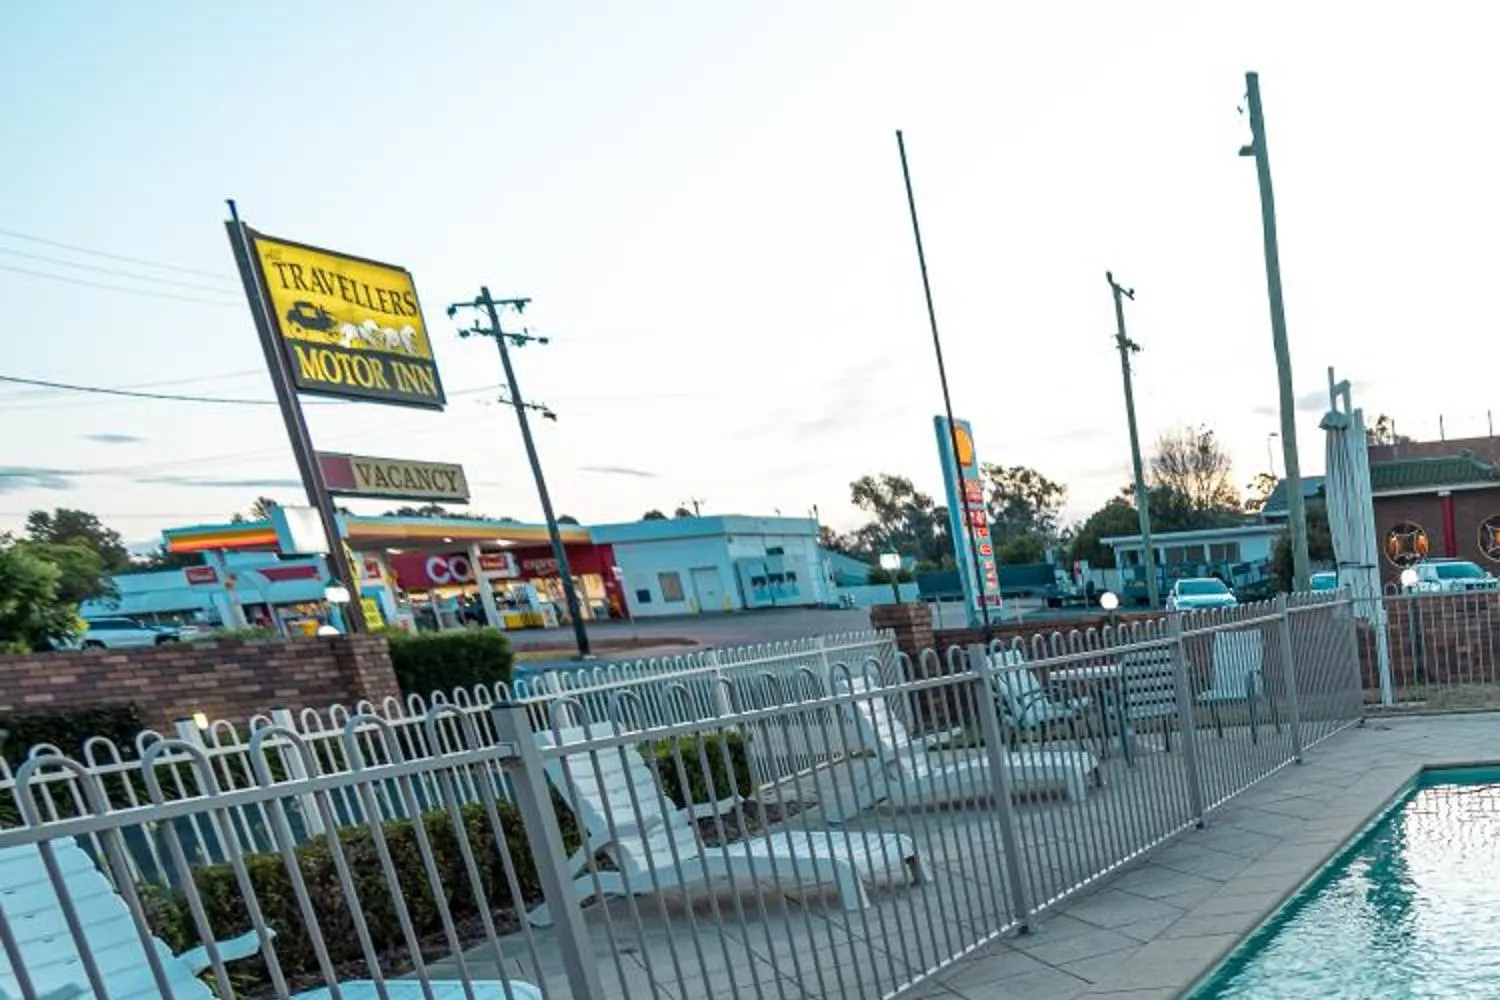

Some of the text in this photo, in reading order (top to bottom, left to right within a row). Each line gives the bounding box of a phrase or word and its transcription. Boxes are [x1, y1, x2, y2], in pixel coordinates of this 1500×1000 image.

[272, 261, 417, 318] TRAVELLERS
[293, 345, 438, 397] MOTOR INN
[355, 463, 457, 493] VACANCY
